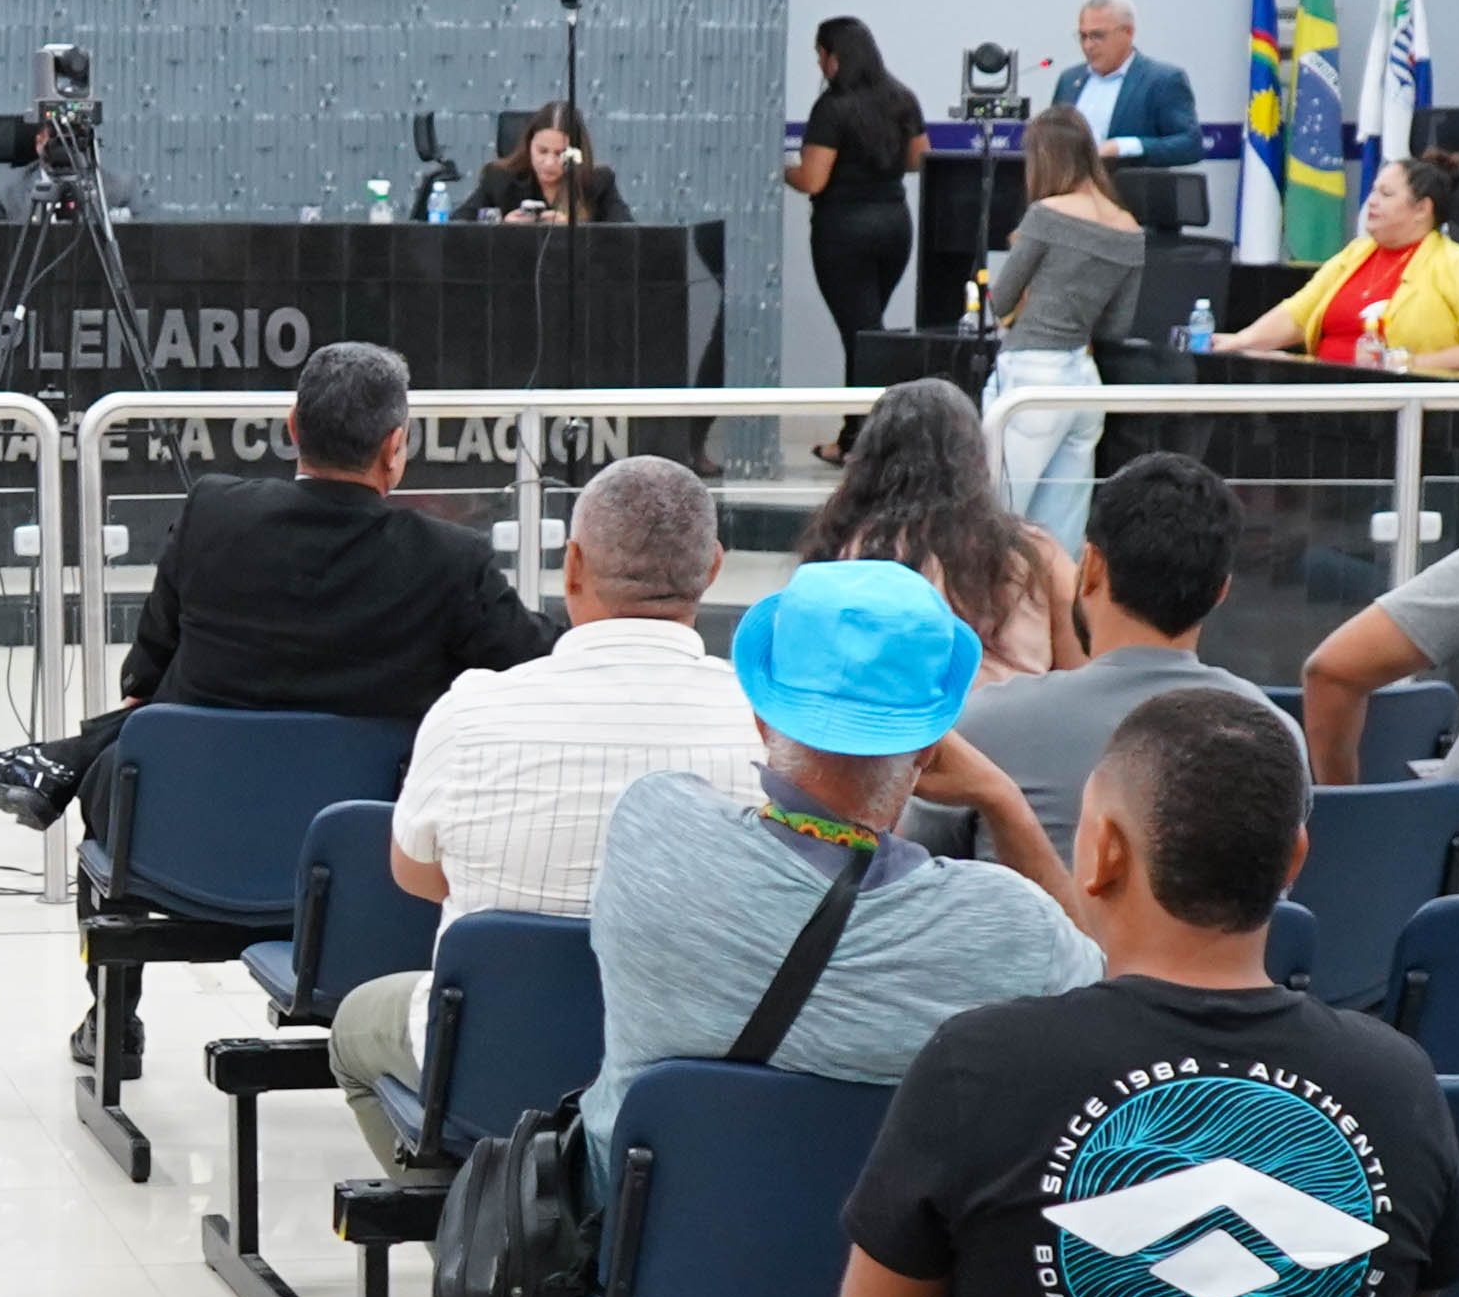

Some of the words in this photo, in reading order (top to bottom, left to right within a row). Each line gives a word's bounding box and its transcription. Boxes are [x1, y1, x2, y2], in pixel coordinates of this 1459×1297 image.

[1041, 1096, 1108, 1194] SINCE
[1113, 1057, 1199, 1095] 1984
[1248, 1062, 1392, 1214] AUTHENTIC
